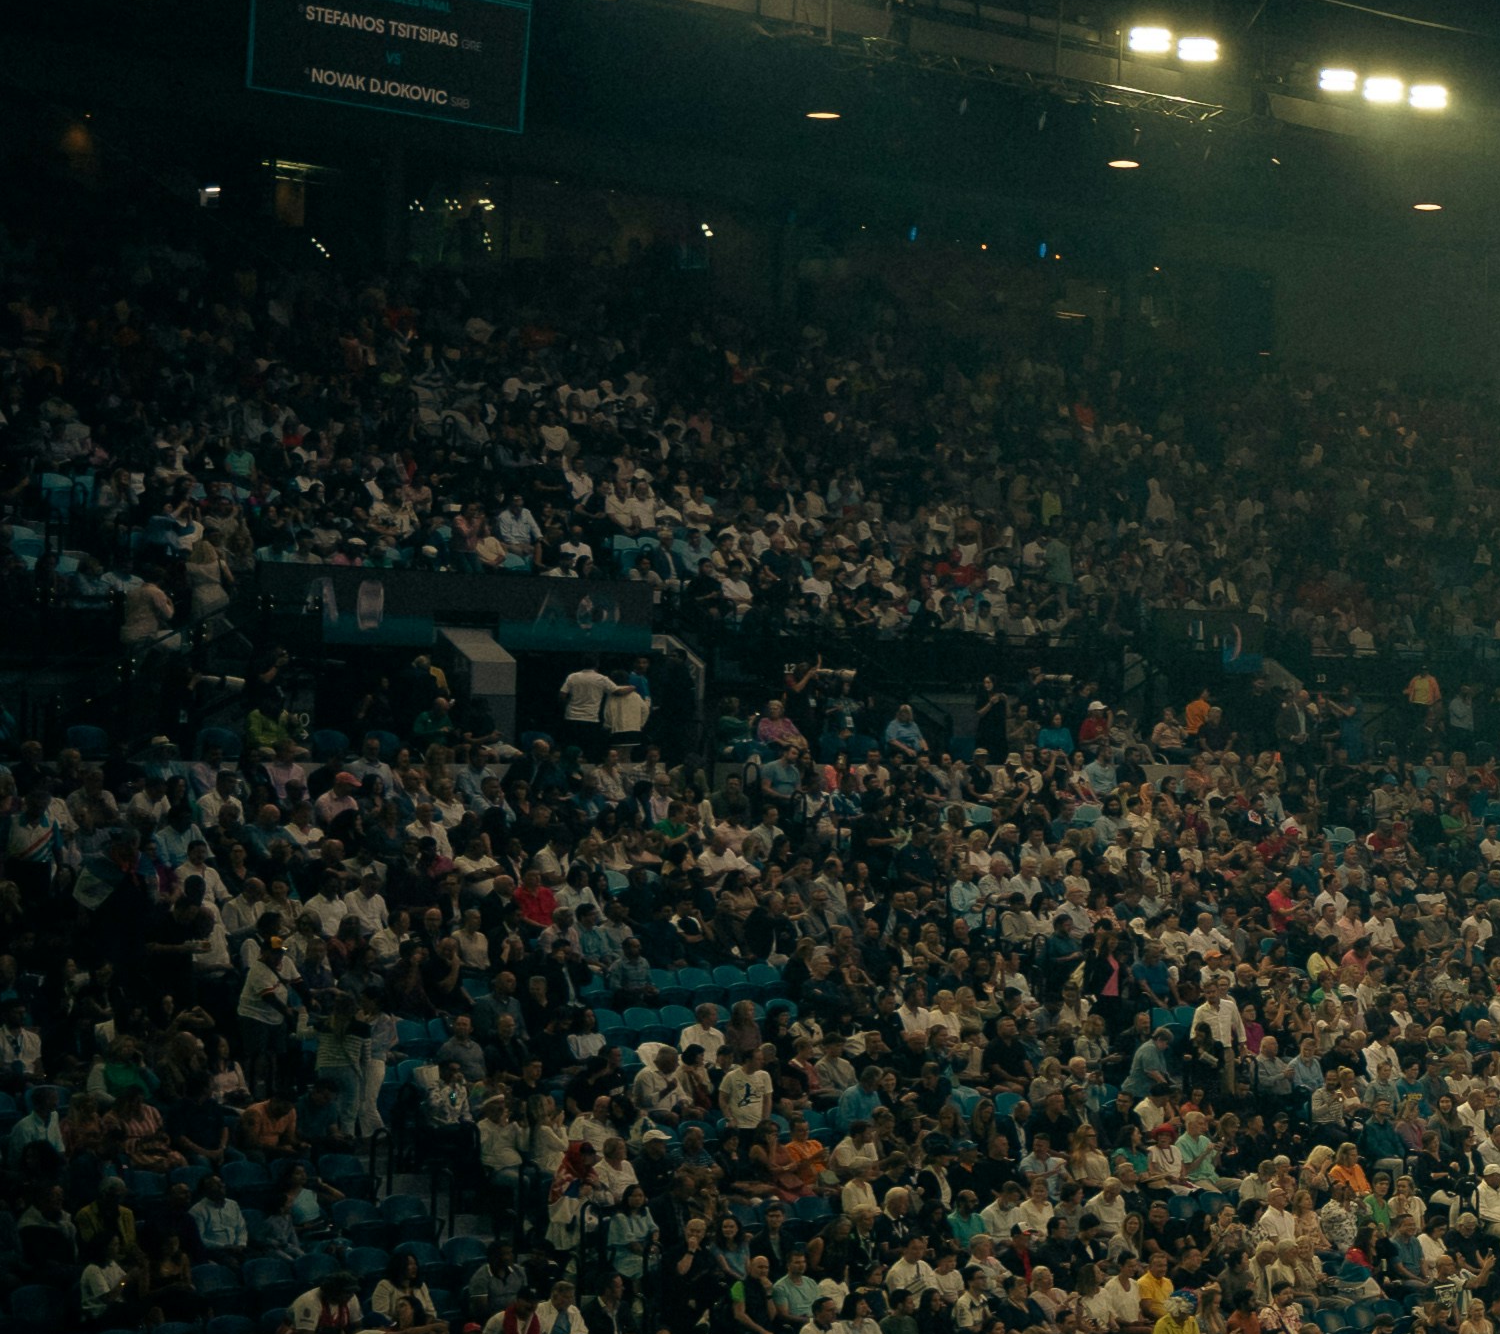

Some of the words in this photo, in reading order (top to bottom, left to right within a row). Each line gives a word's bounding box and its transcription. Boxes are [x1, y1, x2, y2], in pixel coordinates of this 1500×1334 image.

[306, 5, 385, 35] STEFANOS
[389, 20, 459, 48] TSITSIPAS
[311, 68, 366, 92] NOVAK
[369, 78, 448, 106] DJOKOVIC
[783, 663, 797, 674] 12
